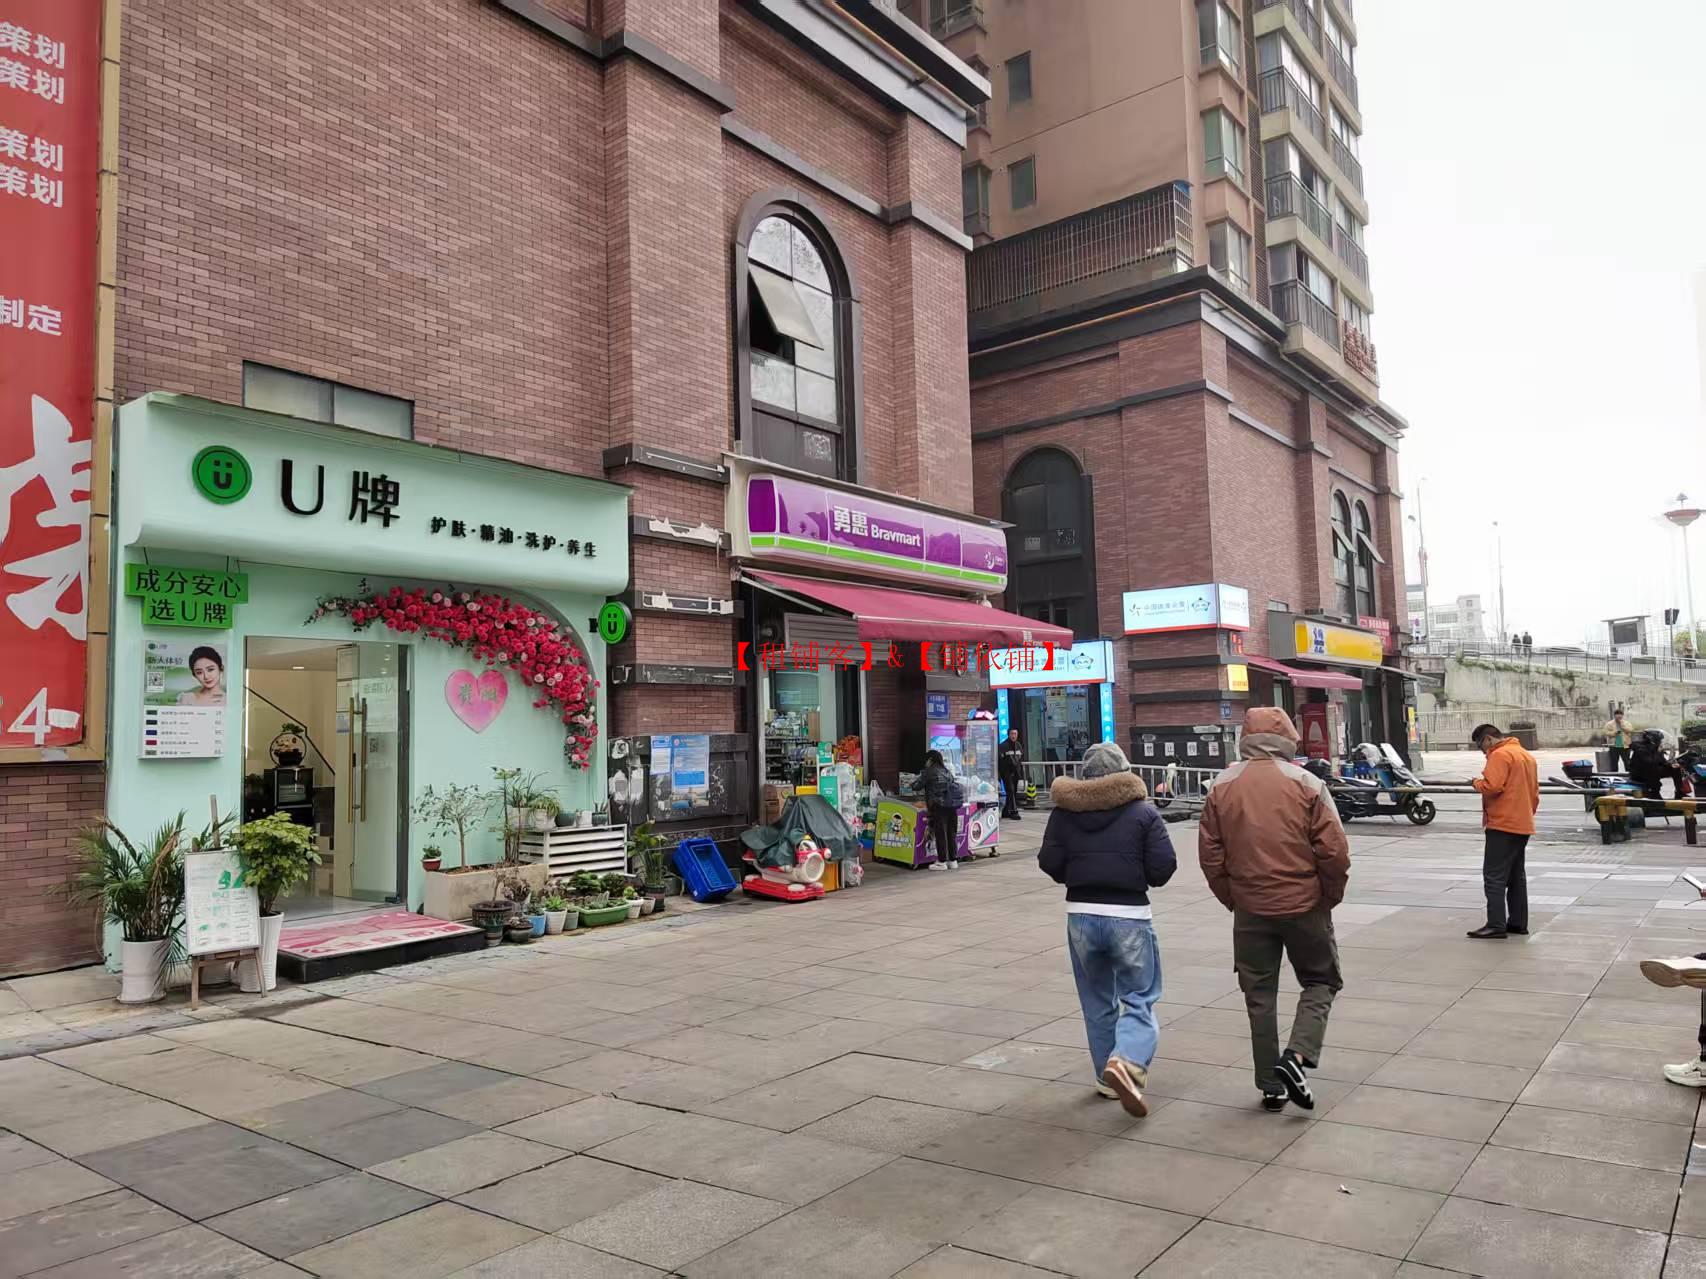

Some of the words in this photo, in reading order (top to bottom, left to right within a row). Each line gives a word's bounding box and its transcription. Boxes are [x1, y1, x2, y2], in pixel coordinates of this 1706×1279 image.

[0, 20, 65, 70] 策划
[0, 56, 64, 105] 策划
[833, 505, 868, 537] 勇惠
[870, 523, 921, 547] Bravmart
[135, 568, 241, 599] 成分安心
[149, 598, 227, 624] 选U牌
